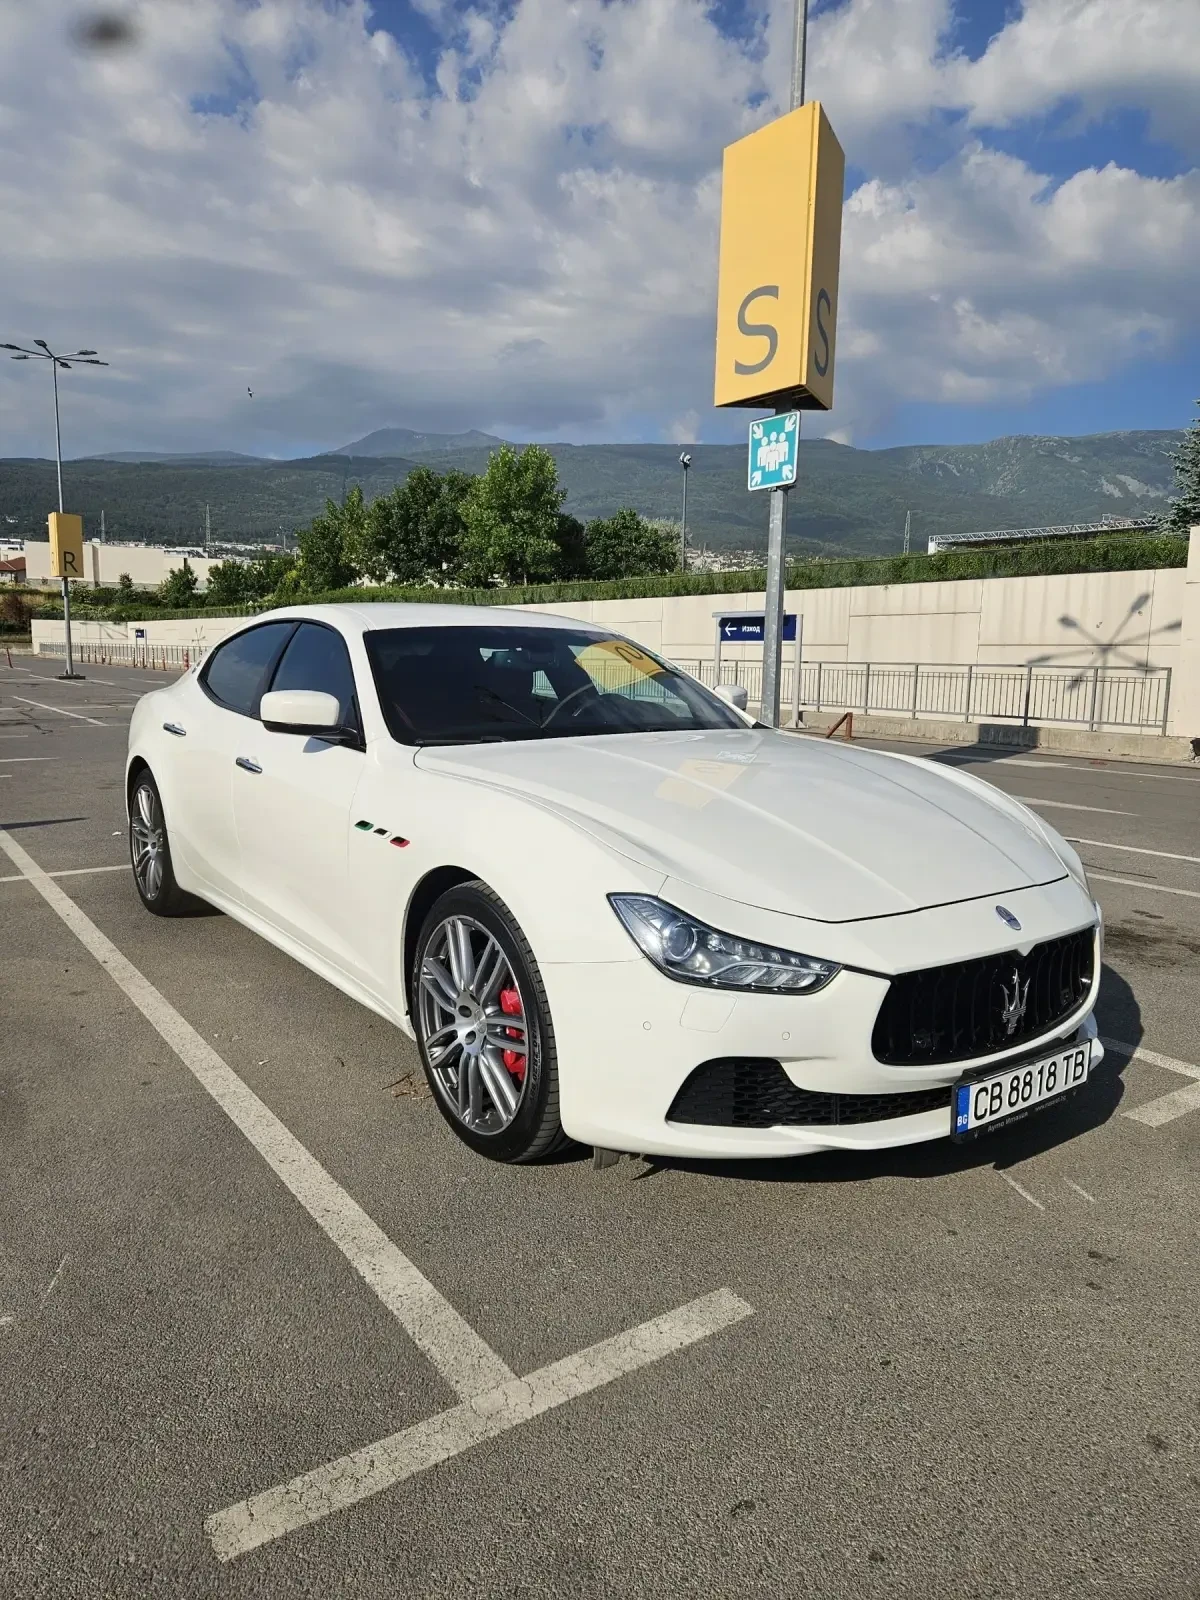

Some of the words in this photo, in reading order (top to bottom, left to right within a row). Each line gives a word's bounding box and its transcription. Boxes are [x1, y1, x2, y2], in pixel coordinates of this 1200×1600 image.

[734, 285, 779, 375] S
[814, 287, 831, 377] S
[63, 550, 78, 573] R
[741, 625, 760, 633] Изход
[973, 1081, 1003, 1121] CB
[1007, 1060, 1058, 1108] 8818
[1062, 1050, 1085, 1086] TB
[957, 1114, 968, 1127] BG
